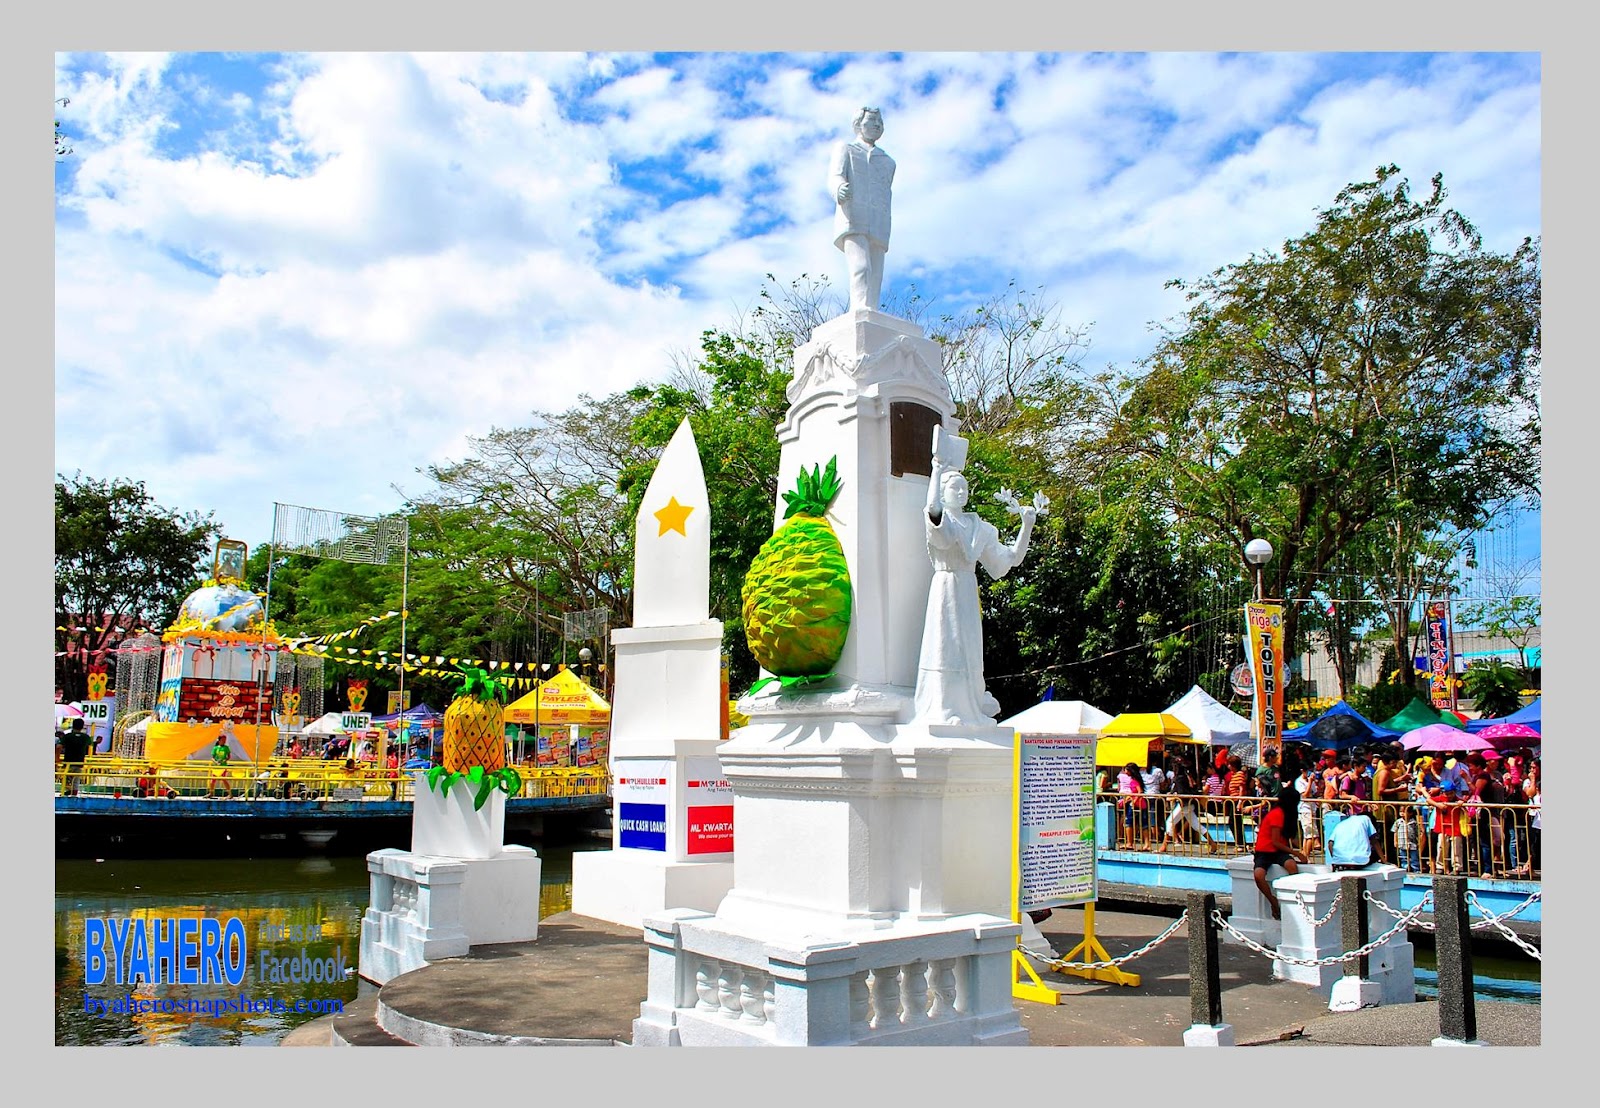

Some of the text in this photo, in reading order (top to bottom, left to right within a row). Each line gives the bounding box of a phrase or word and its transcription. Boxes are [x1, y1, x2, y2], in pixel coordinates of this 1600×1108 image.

[1260, 632, 1276, 738] TOURISM
[82, 704, 107, 718] PNB
[342, 715, 369, 729] UNEP
[620, 819, 666, 833] QUICK CASH LOANS
[704, 823, 734, 832] KWARTA
